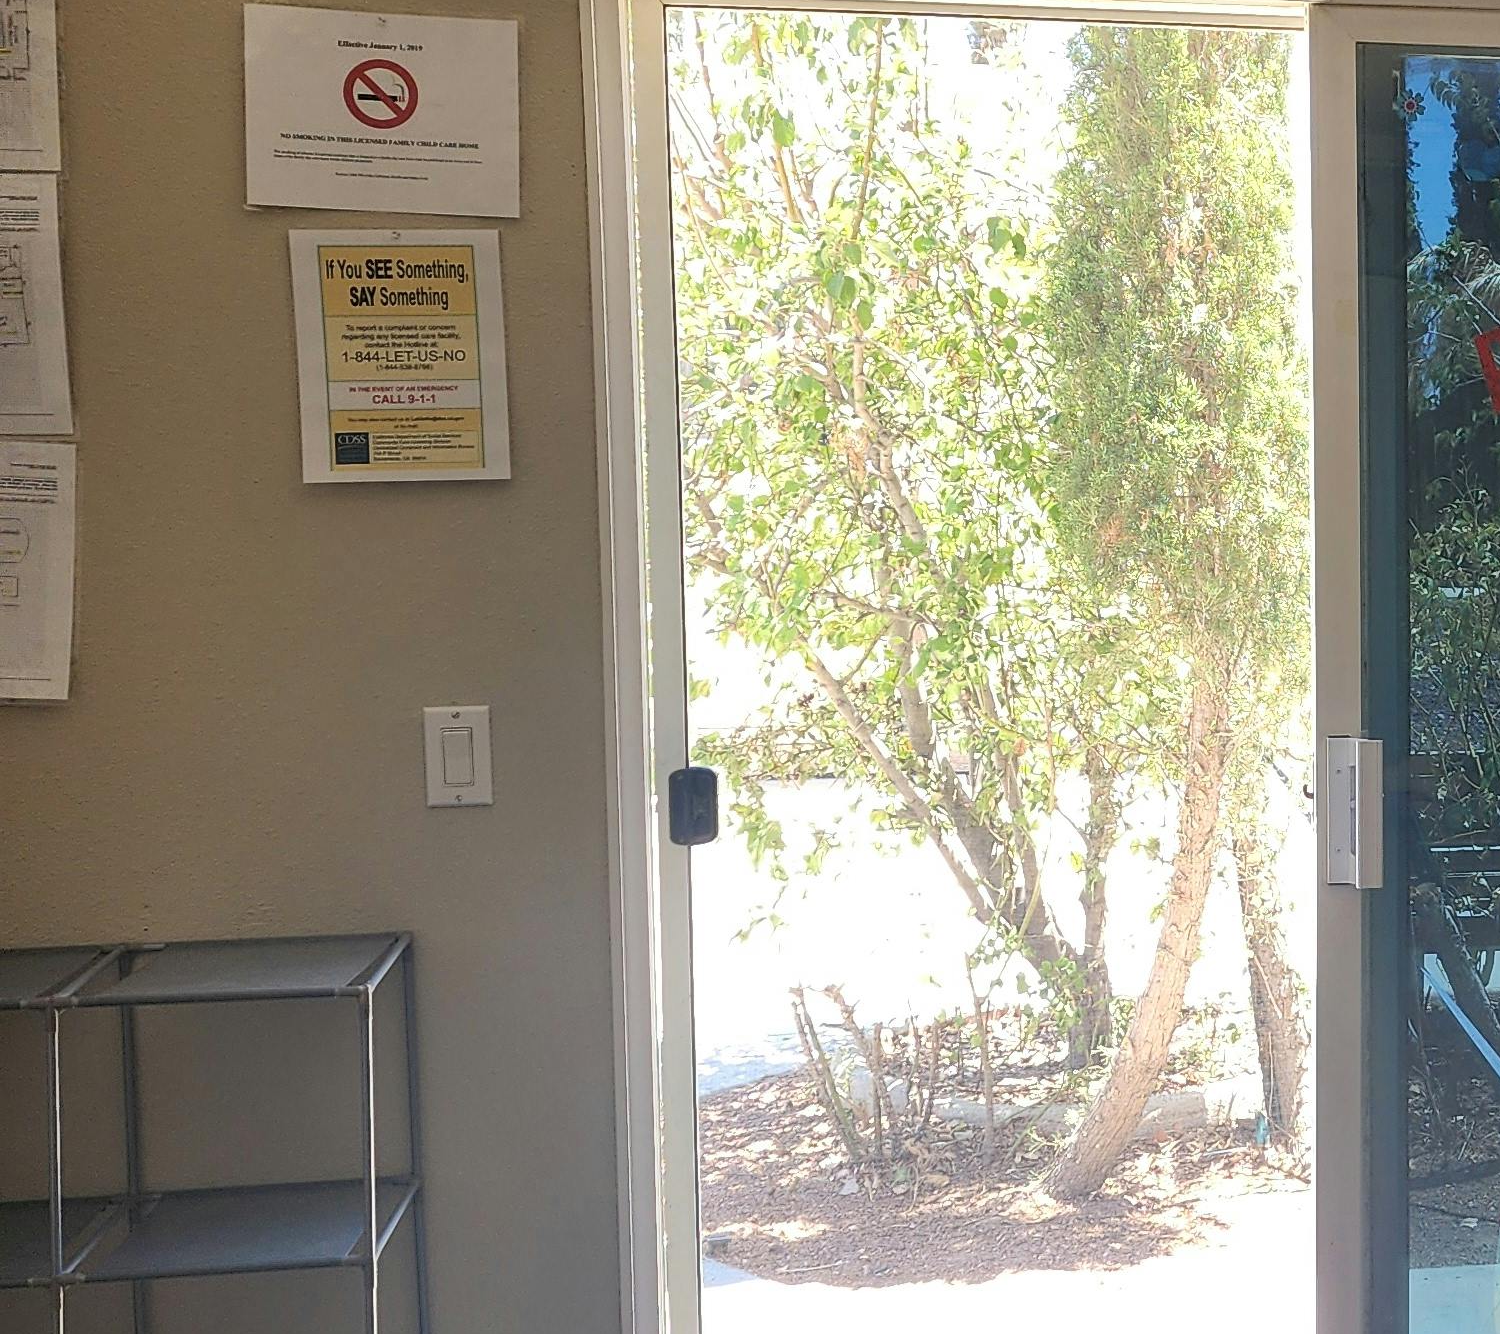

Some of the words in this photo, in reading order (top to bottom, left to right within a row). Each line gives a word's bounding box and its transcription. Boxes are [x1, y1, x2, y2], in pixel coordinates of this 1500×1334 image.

[292, 133, 326, 142] SMOKING
[388, 139, 415, 147] FAMILY
[325, 259, 335, 279] If
[337, 259, 362, 279] You
[365, 259, 393, 279] SEE
[396, 259, 469, 283] Something,
[350, 286, 377, 307] SAY
[380, 287, 449, 310] Something
[341, 349, 466, 363] 1-844-LET-US-NO
[372, 394, 405, 405] CALL
[408, 394, 437, 404] 9-1-1
[337, 434, 366, 445] CDSS
